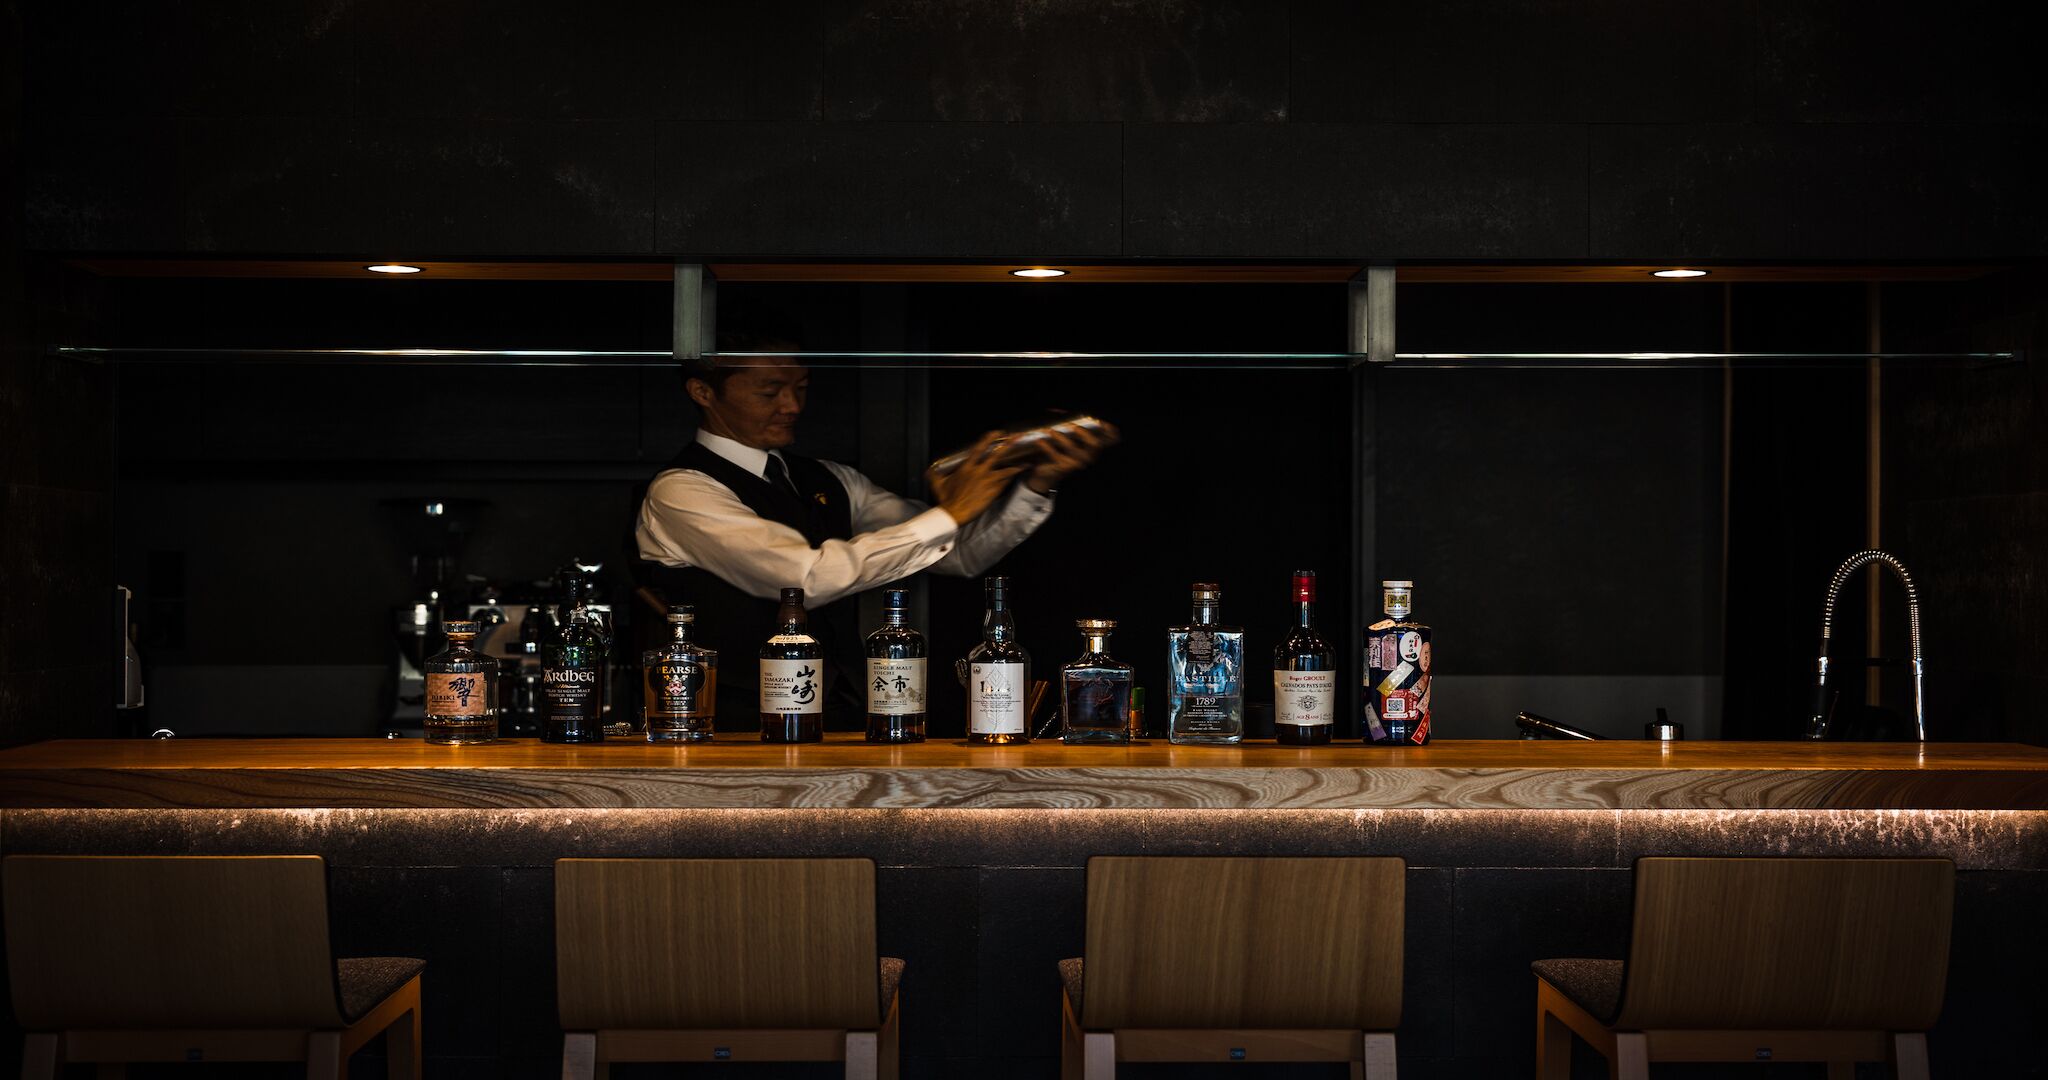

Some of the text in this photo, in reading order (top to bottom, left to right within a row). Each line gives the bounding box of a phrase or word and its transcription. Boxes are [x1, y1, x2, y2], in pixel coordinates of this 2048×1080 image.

[449, 677, 480, 707] 響
[792, 665, 817, 704] 山崎
[872, 676, 910, 692] 余市
